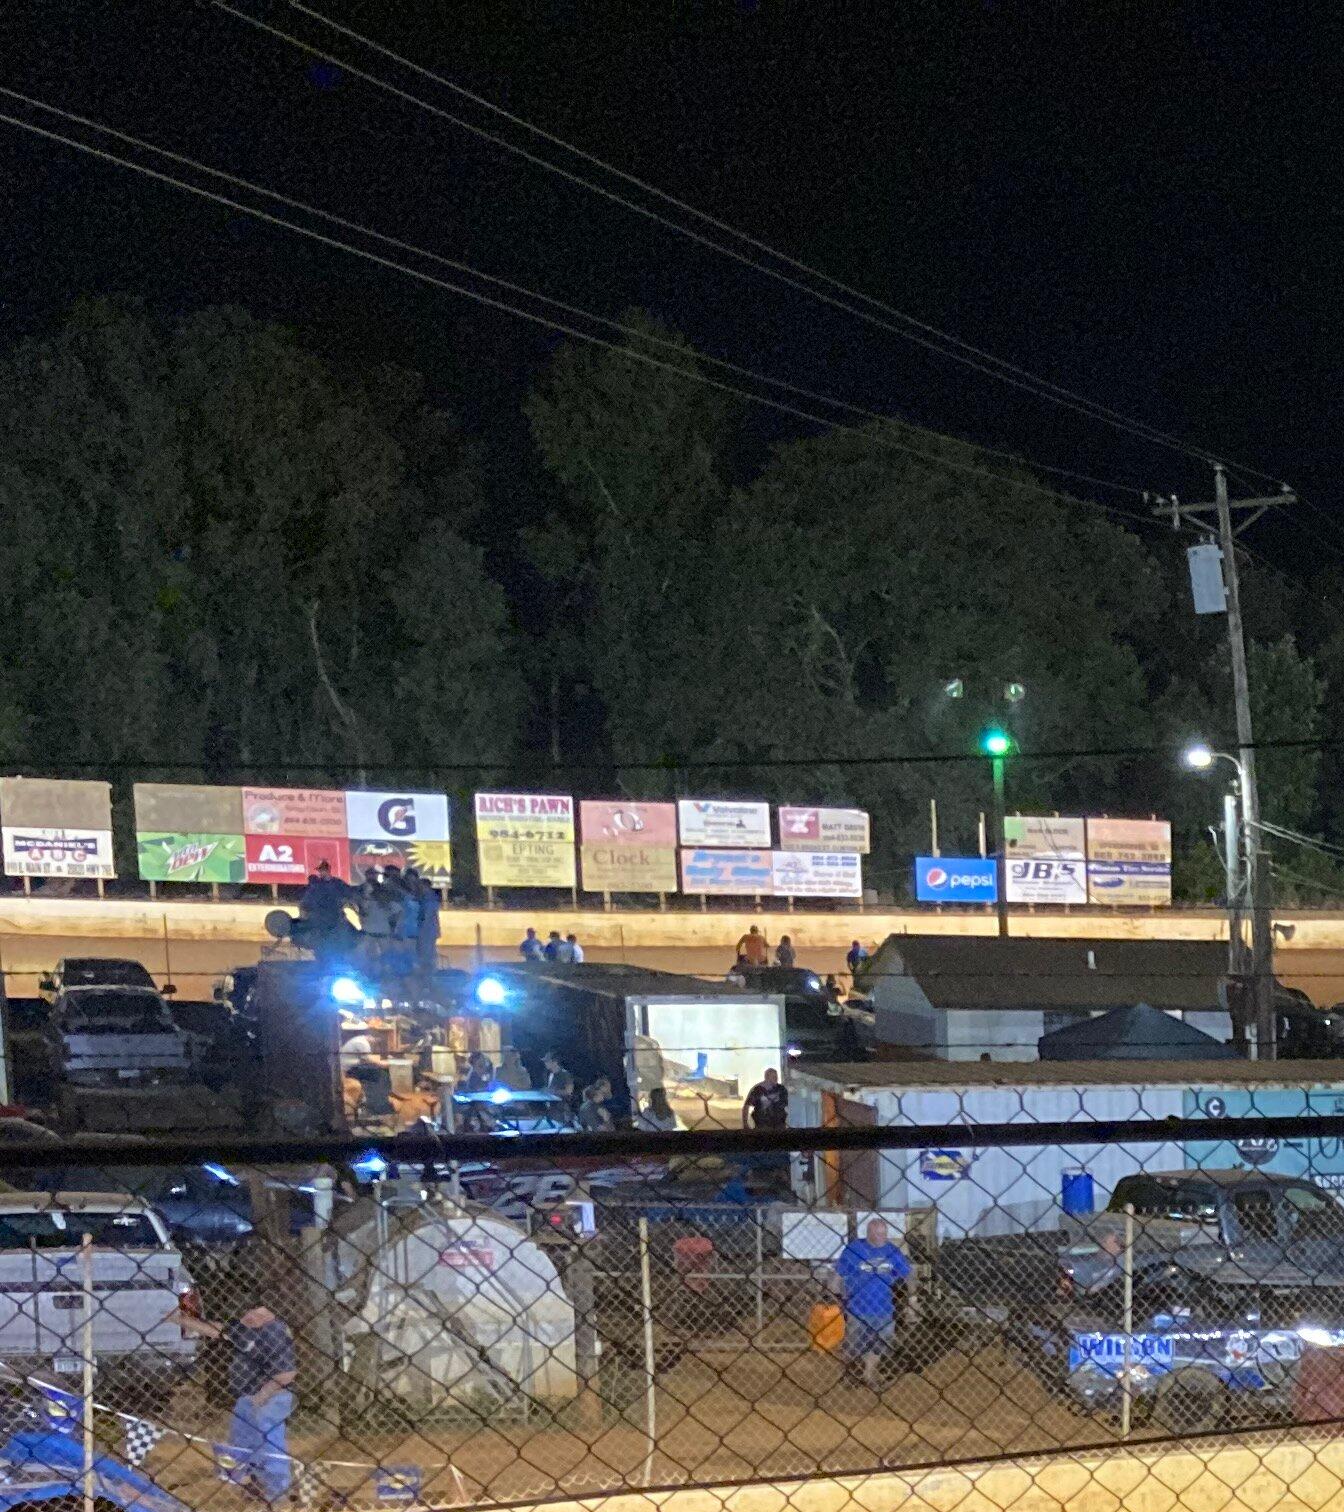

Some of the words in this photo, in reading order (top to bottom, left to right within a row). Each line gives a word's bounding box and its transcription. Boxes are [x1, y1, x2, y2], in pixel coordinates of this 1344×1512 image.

[478, 796, 526, 814] RICH'S
[531, 798, 570, 815] PAWN
[378, 797, 417, 837] G
[258, 844, 294, 863] A2
[593, 851, 651, 867] Clock
[950, 872, 993, 889] pepsi
